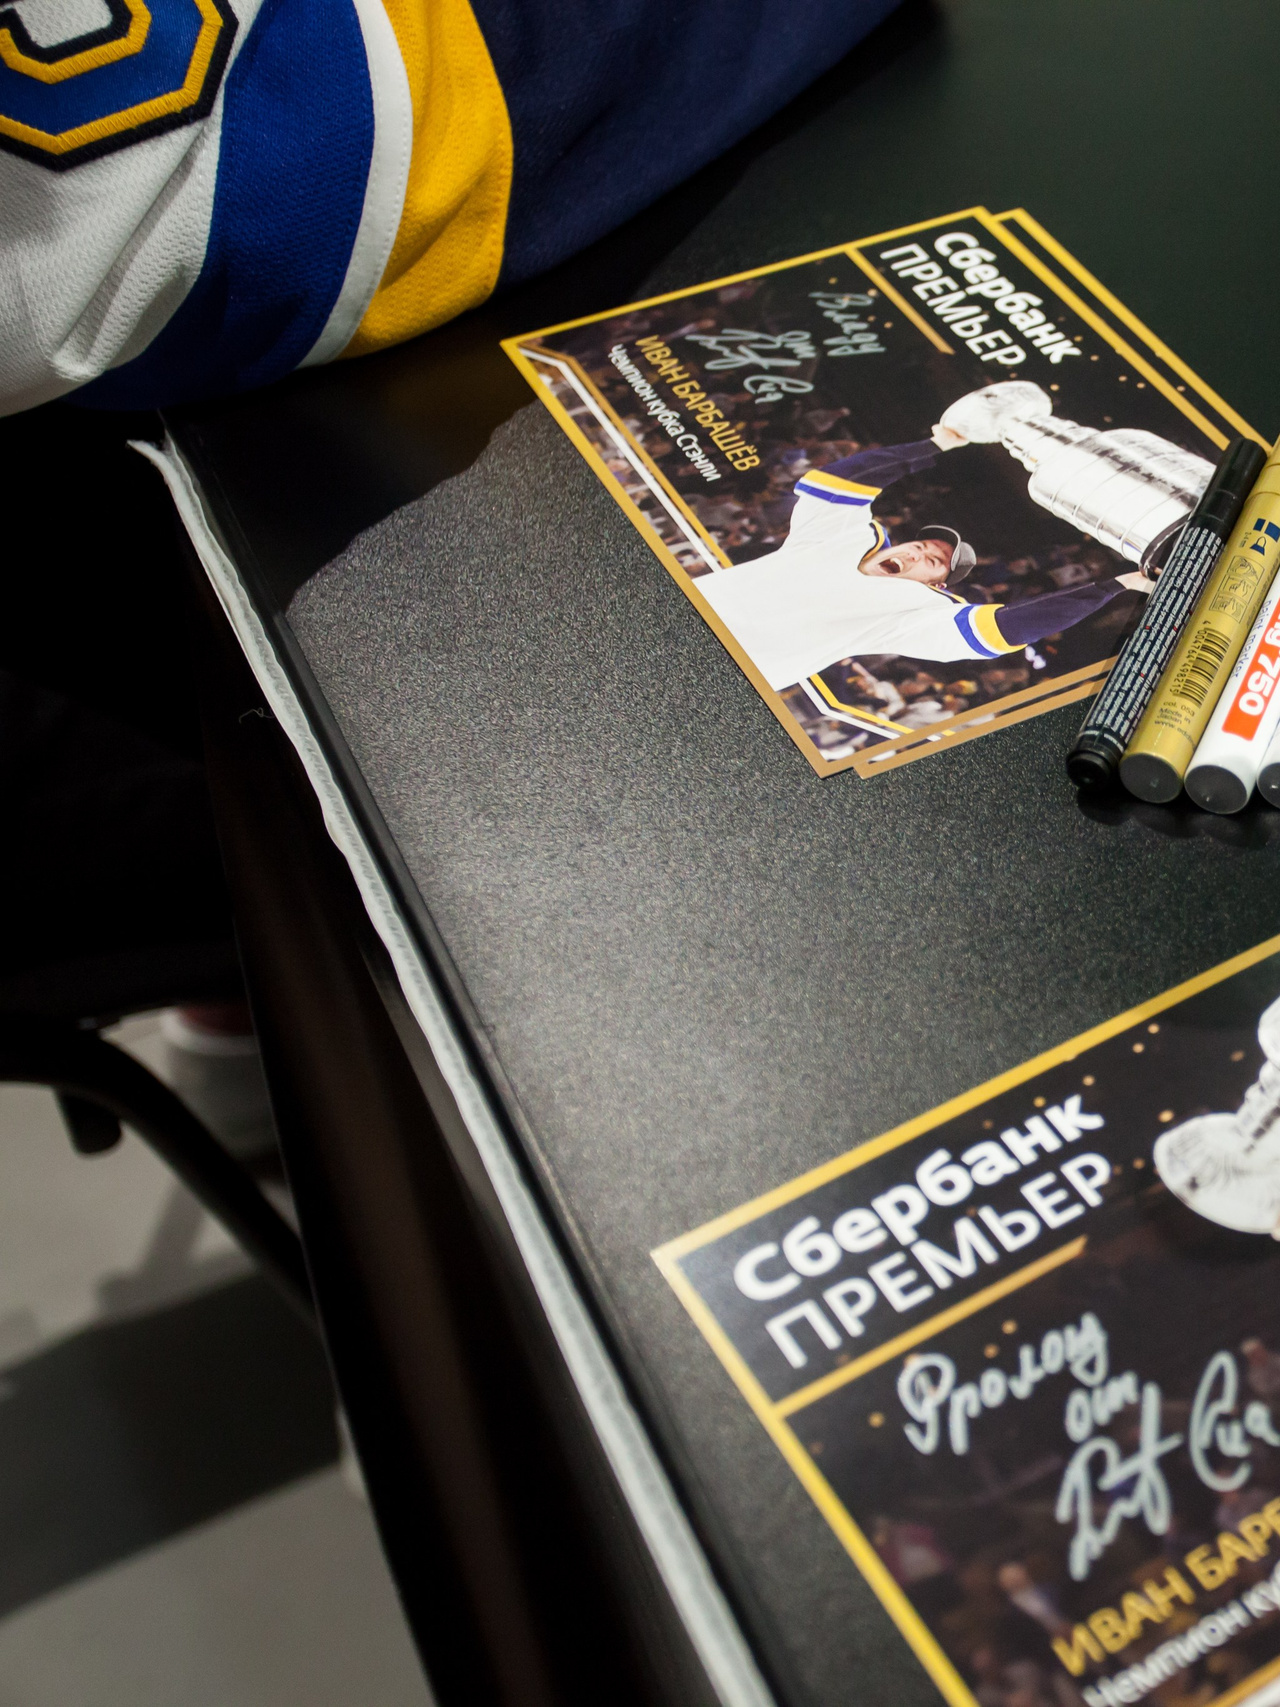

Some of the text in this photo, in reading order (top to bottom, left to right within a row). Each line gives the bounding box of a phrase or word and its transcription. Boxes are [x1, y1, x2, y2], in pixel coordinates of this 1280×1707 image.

[880, 243, 1026, 365] ПРЕМЬЕР
[934, 232, 1082, 364] Сбербанк
[635, 335, 689, 383] ИВАН
[672, 380, 760, 471] БАРБАШЁВ
[647, 398, 685, 437] кубка
[676, 434, 721, 481] Стэнли
[733, 1094, 1104, 1300] Сбербанк
[765, 1152, 1111, 1369] ПРЕМЬЕР
[1052, 1566, 1196, 1676] ИВАН
